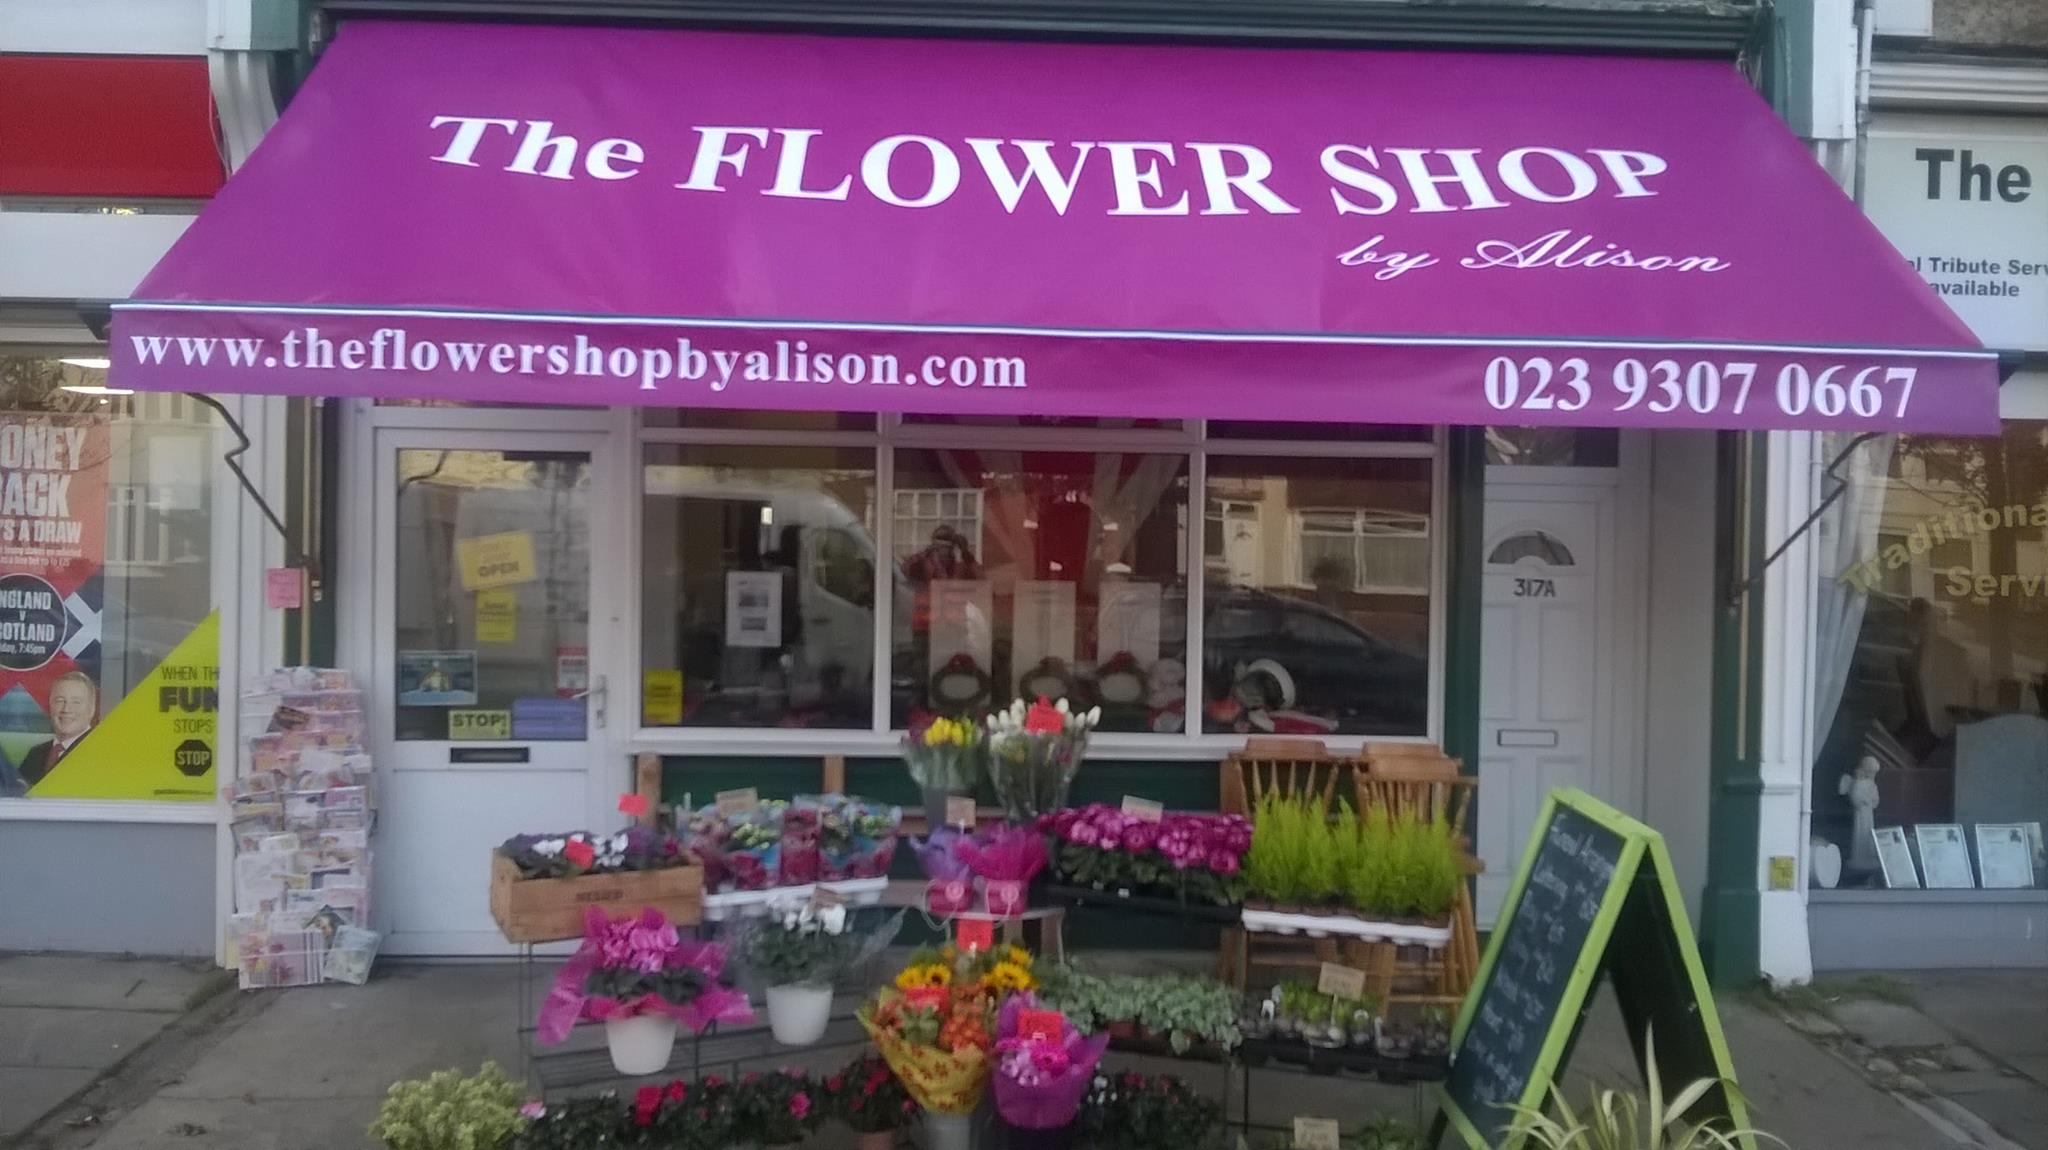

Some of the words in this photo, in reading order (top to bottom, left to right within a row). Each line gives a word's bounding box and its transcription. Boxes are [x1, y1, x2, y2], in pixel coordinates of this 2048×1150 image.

[430, 115, 644, 180] The
[674, 126, 1301, 216] FLOWER
[1319, 144, 1668, 215] SHOP
[1915, 148, 2032, 203] The
[1335, 235, 1439, 281] by
[1460, 229, 1731, 273] Alison
[1928, 257, 2001, 275] Tribute
[131, 327, 1028, 391] www.theflowershopbyalison.com
[1484, 356, 1592, 411] 023
[1612, 358, 1758, 415] 9307
[1776, 363, 1918, 418] 0667
[0, 471, 72, 517] ACK
[33, 519, 82, 543] DRAW
[1513, 578, 1556, 598] 317A
[162, 666, 199, 681] WHEN
[174, 718, 214, 734] STOPS
[176, 751, 210, 766] STOP
